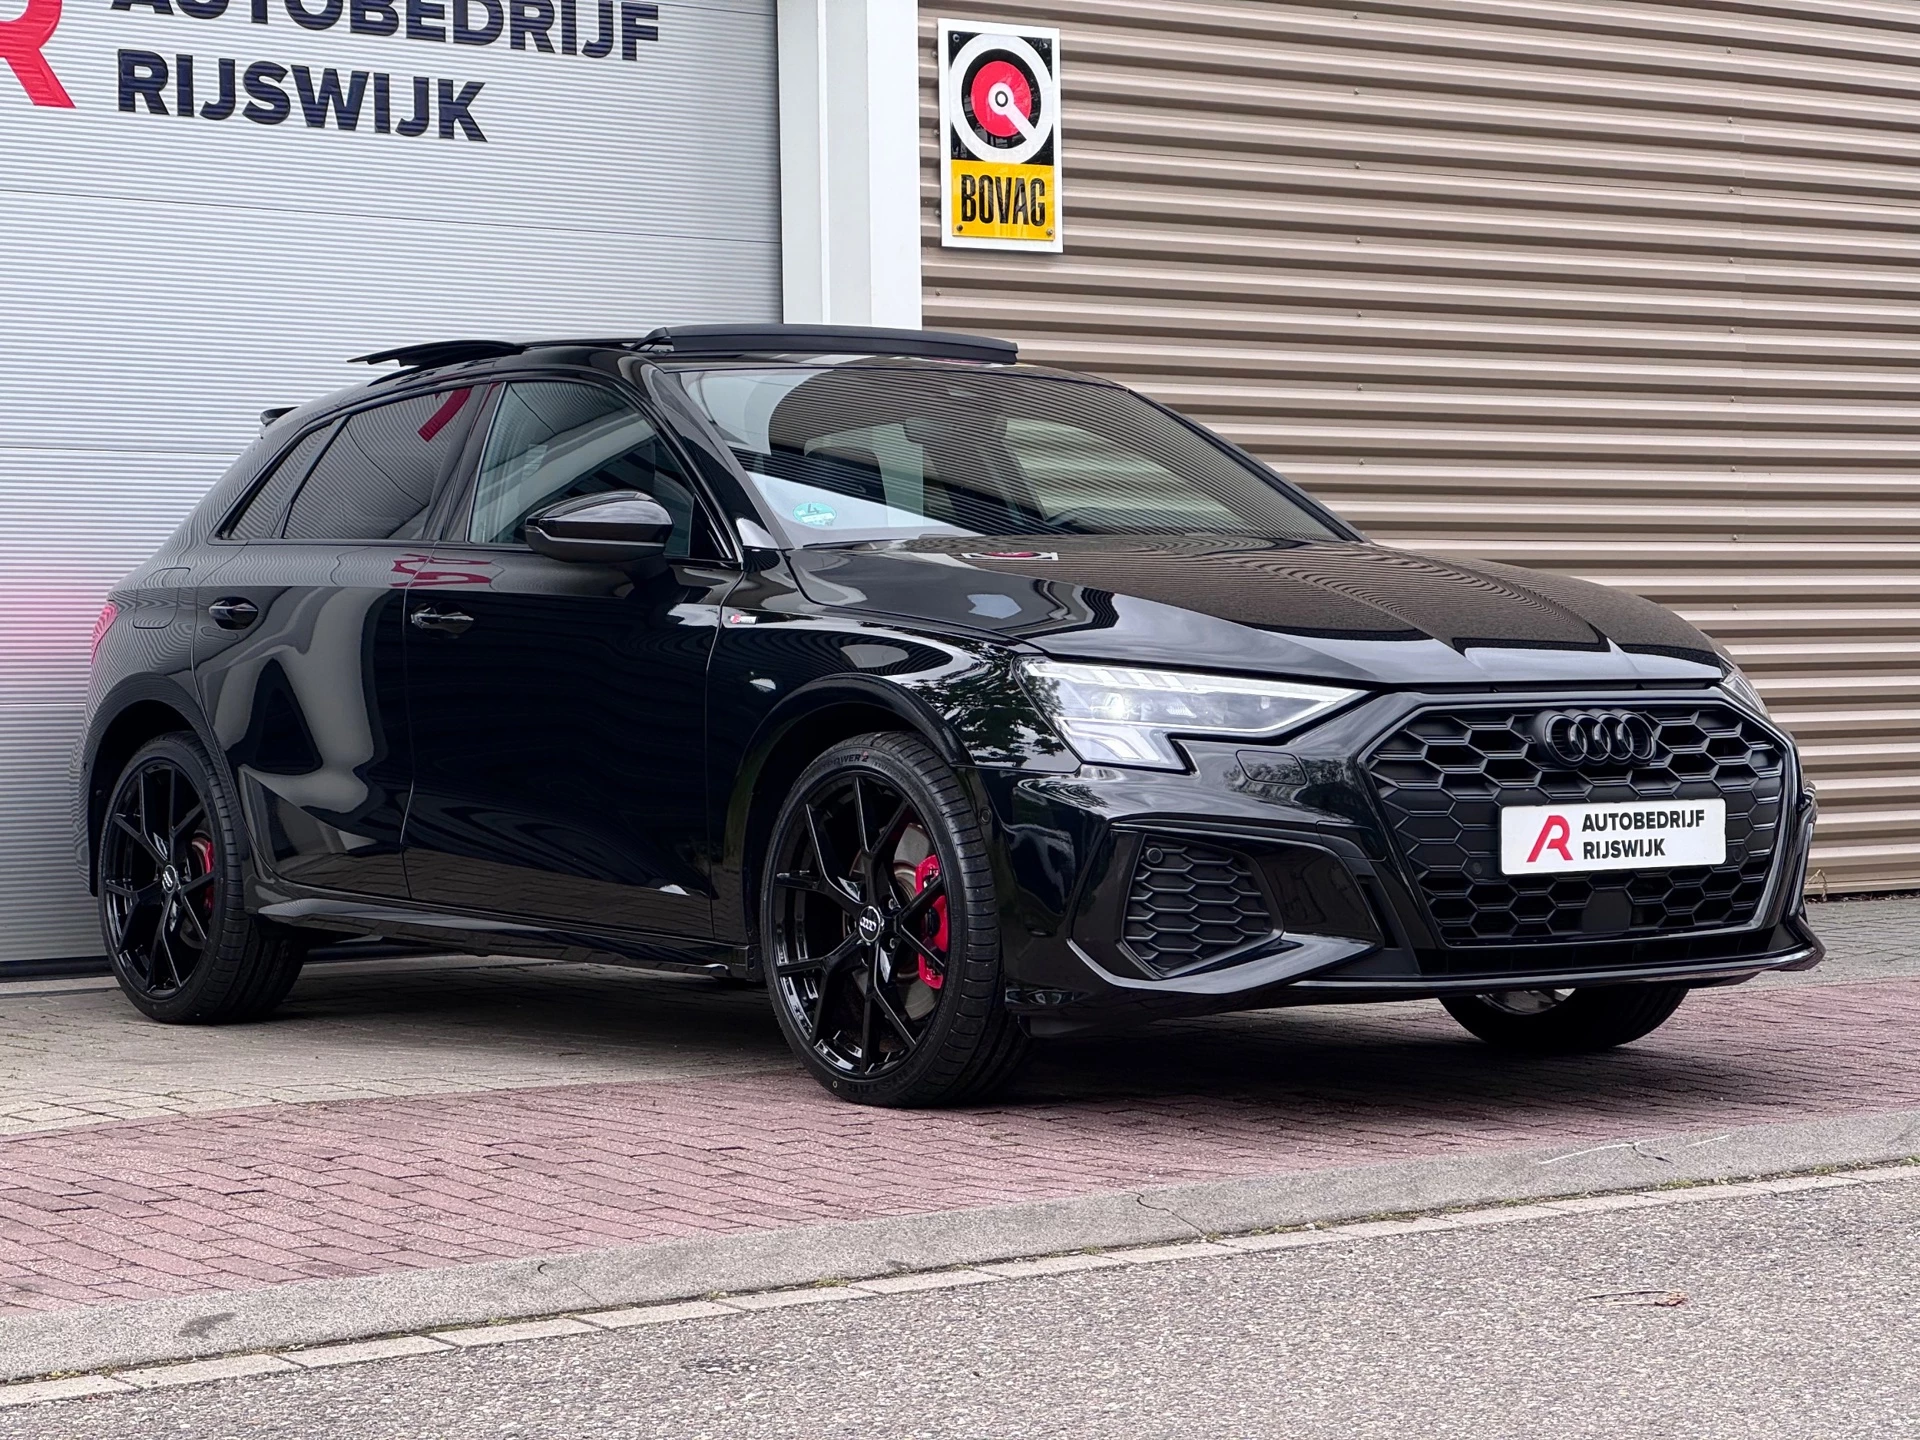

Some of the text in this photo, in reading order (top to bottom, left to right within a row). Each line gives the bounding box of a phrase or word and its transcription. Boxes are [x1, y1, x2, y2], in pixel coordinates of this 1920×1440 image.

[110, 0, 660, 61] BEDRIJF
[117, 48, 487, 142] RIJSWIJK
[961, 174, 1046, 226] BOVAG
[1581, 809, 1705, 832] AUTOBEDRIJF
[1582, 838, 1666, 860] RIJSWIJK
